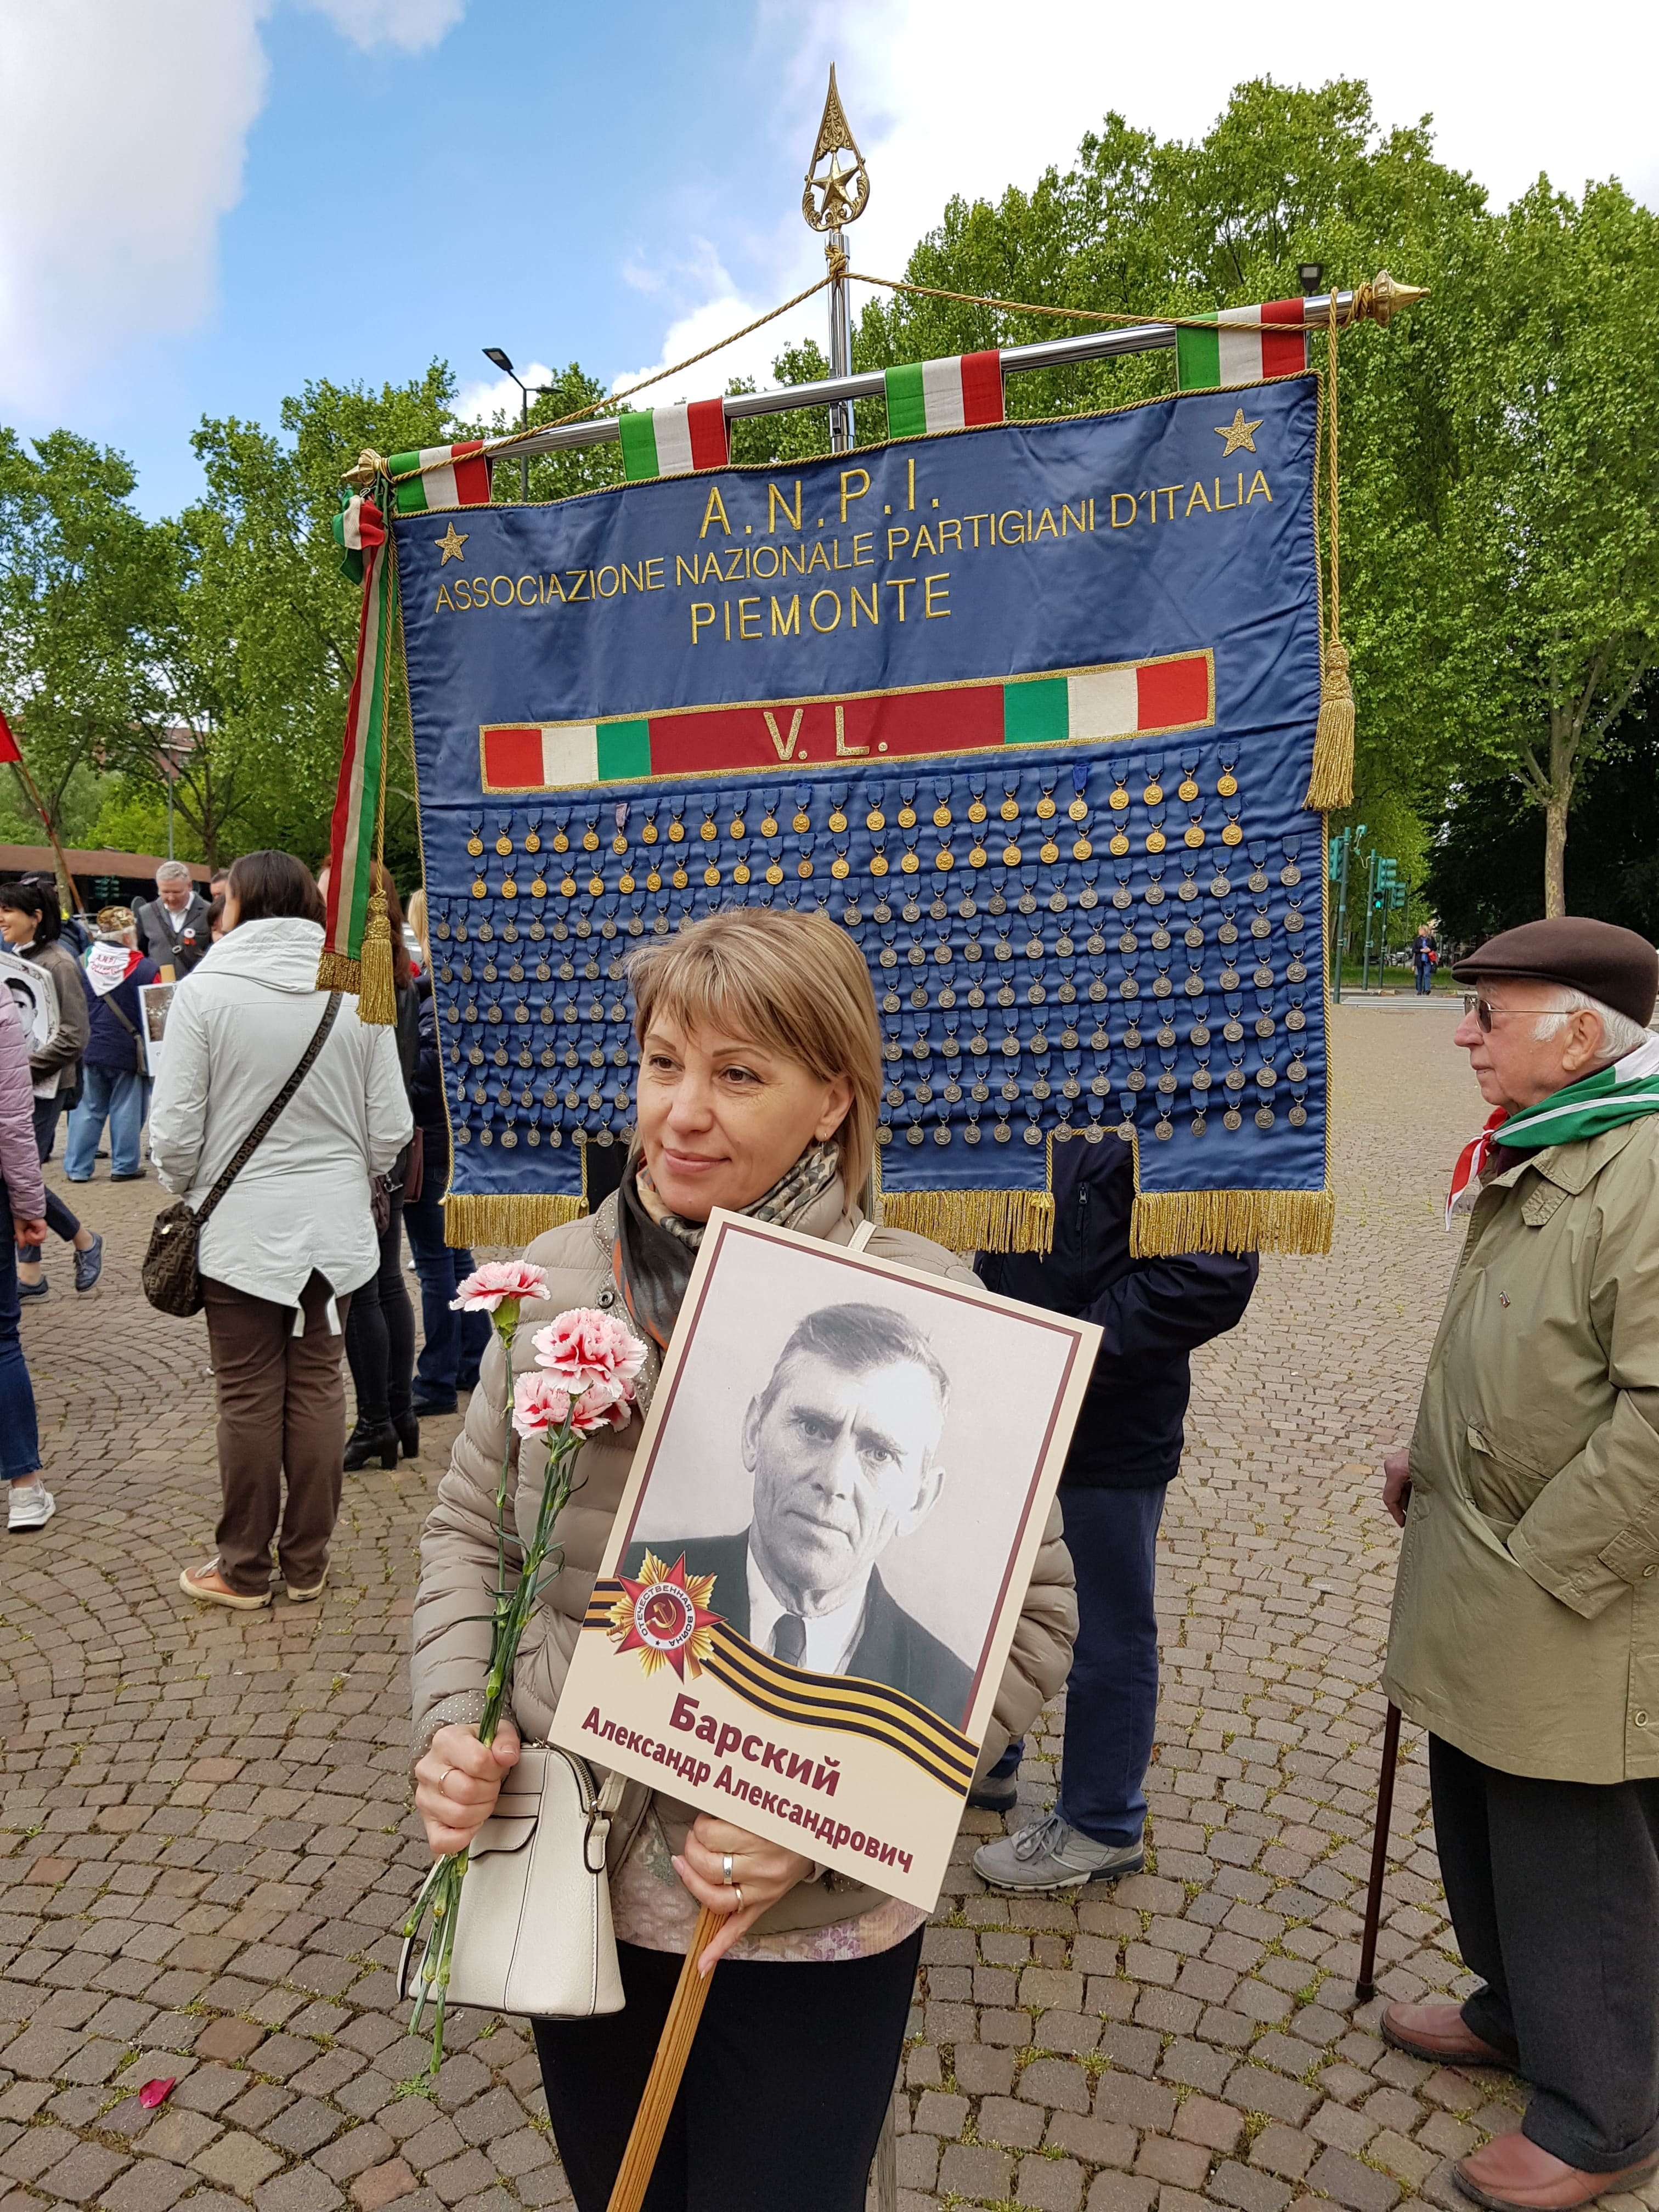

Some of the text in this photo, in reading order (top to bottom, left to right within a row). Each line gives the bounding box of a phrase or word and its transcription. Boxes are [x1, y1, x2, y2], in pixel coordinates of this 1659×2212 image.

[435, 469, 1273, 613] ASSOCIAZIONE NAZIONALE PARTIGIANI D'ITALIA
[690, 572, 952, 645] PIEMONTE
[254, 1105, 281, 1141] FENDI
[223, 1145, 253, 1179] ROMA
[637, 1585, 692, 1635] ОТЕЧЕСТВЕННАЯ
[668, 1693, 841, 1797] Барский
[581, 1706, 913, 1873] Александр Александрович
